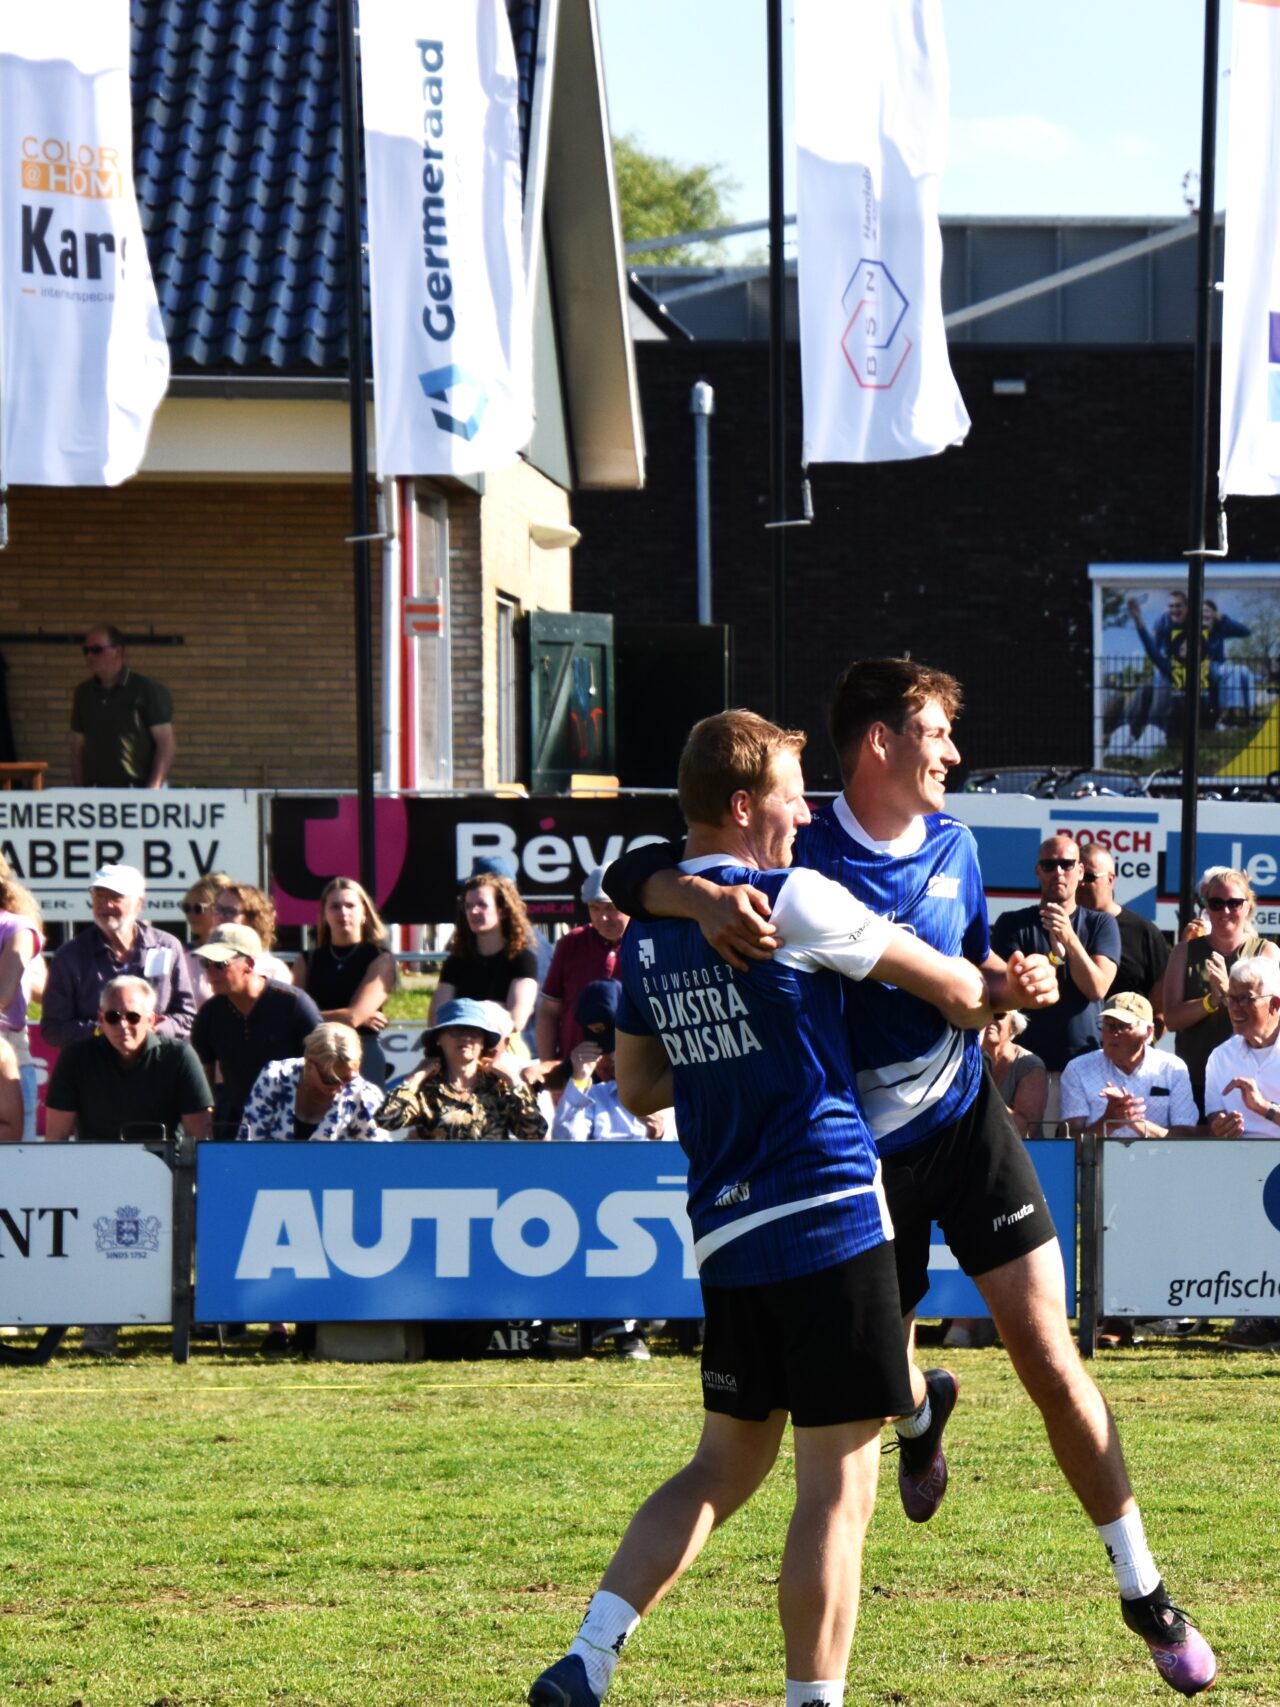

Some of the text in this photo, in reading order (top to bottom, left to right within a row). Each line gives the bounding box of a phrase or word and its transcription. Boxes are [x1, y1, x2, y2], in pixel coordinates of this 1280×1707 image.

[22, 136, 118, 168] COLOR
[414, 38, 456, 342] Germeraad
[21, 204, 127, 280] Kar
[524, 902, 576, 914] onit.nl
